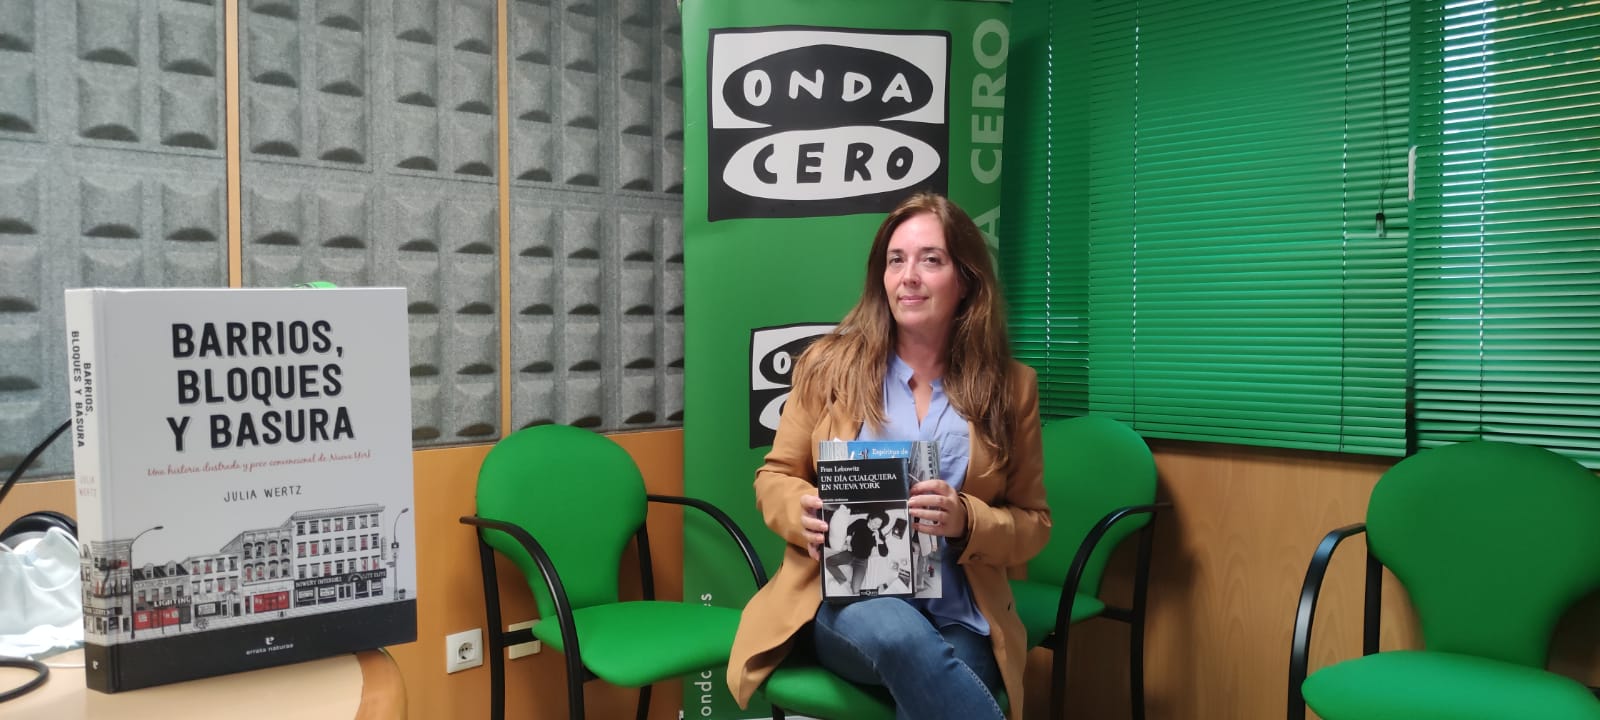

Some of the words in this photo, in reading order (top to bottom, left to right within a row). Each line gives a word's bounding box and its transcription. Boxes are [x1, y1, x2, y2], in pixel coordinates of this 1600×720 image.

[743, 68, 913, 107] ONDA
[970, 18, 1010, 184] CERO
[752, 142, 914, 185] CERO
[71, 330, 82, 382] BLOQUES
[172, 319, 344, 359] BARRIOS,
[75, 388, 83, 396] Y
[83, 362, 94, 416] BARRIOS,
[177, 363, 343, 407] BLOQUES
[75, 401, 85, 447] BASURA
[166, 416, 191, 452] Y
[210, 406, 356, 449] BASURA
[167, 463, 201, 475] historia
[202, 459, 240, 473] ilustrada
[318, 452, 327, 462] de
[820, 475, 833, 483] UN
[834, 473, 848, 483] DÍA
[848, 473, 897, 482] CUALQUIERA
[834, 465, 860, 473] Lebowitz
[223, 489, 258, 503] JULIA
[264, 485, 303, 499] WERTZ
[821, 483, 832, 491] EN
[833, 482, 858, 491] NUEVA
[859, 482, 880, 490] YORK
